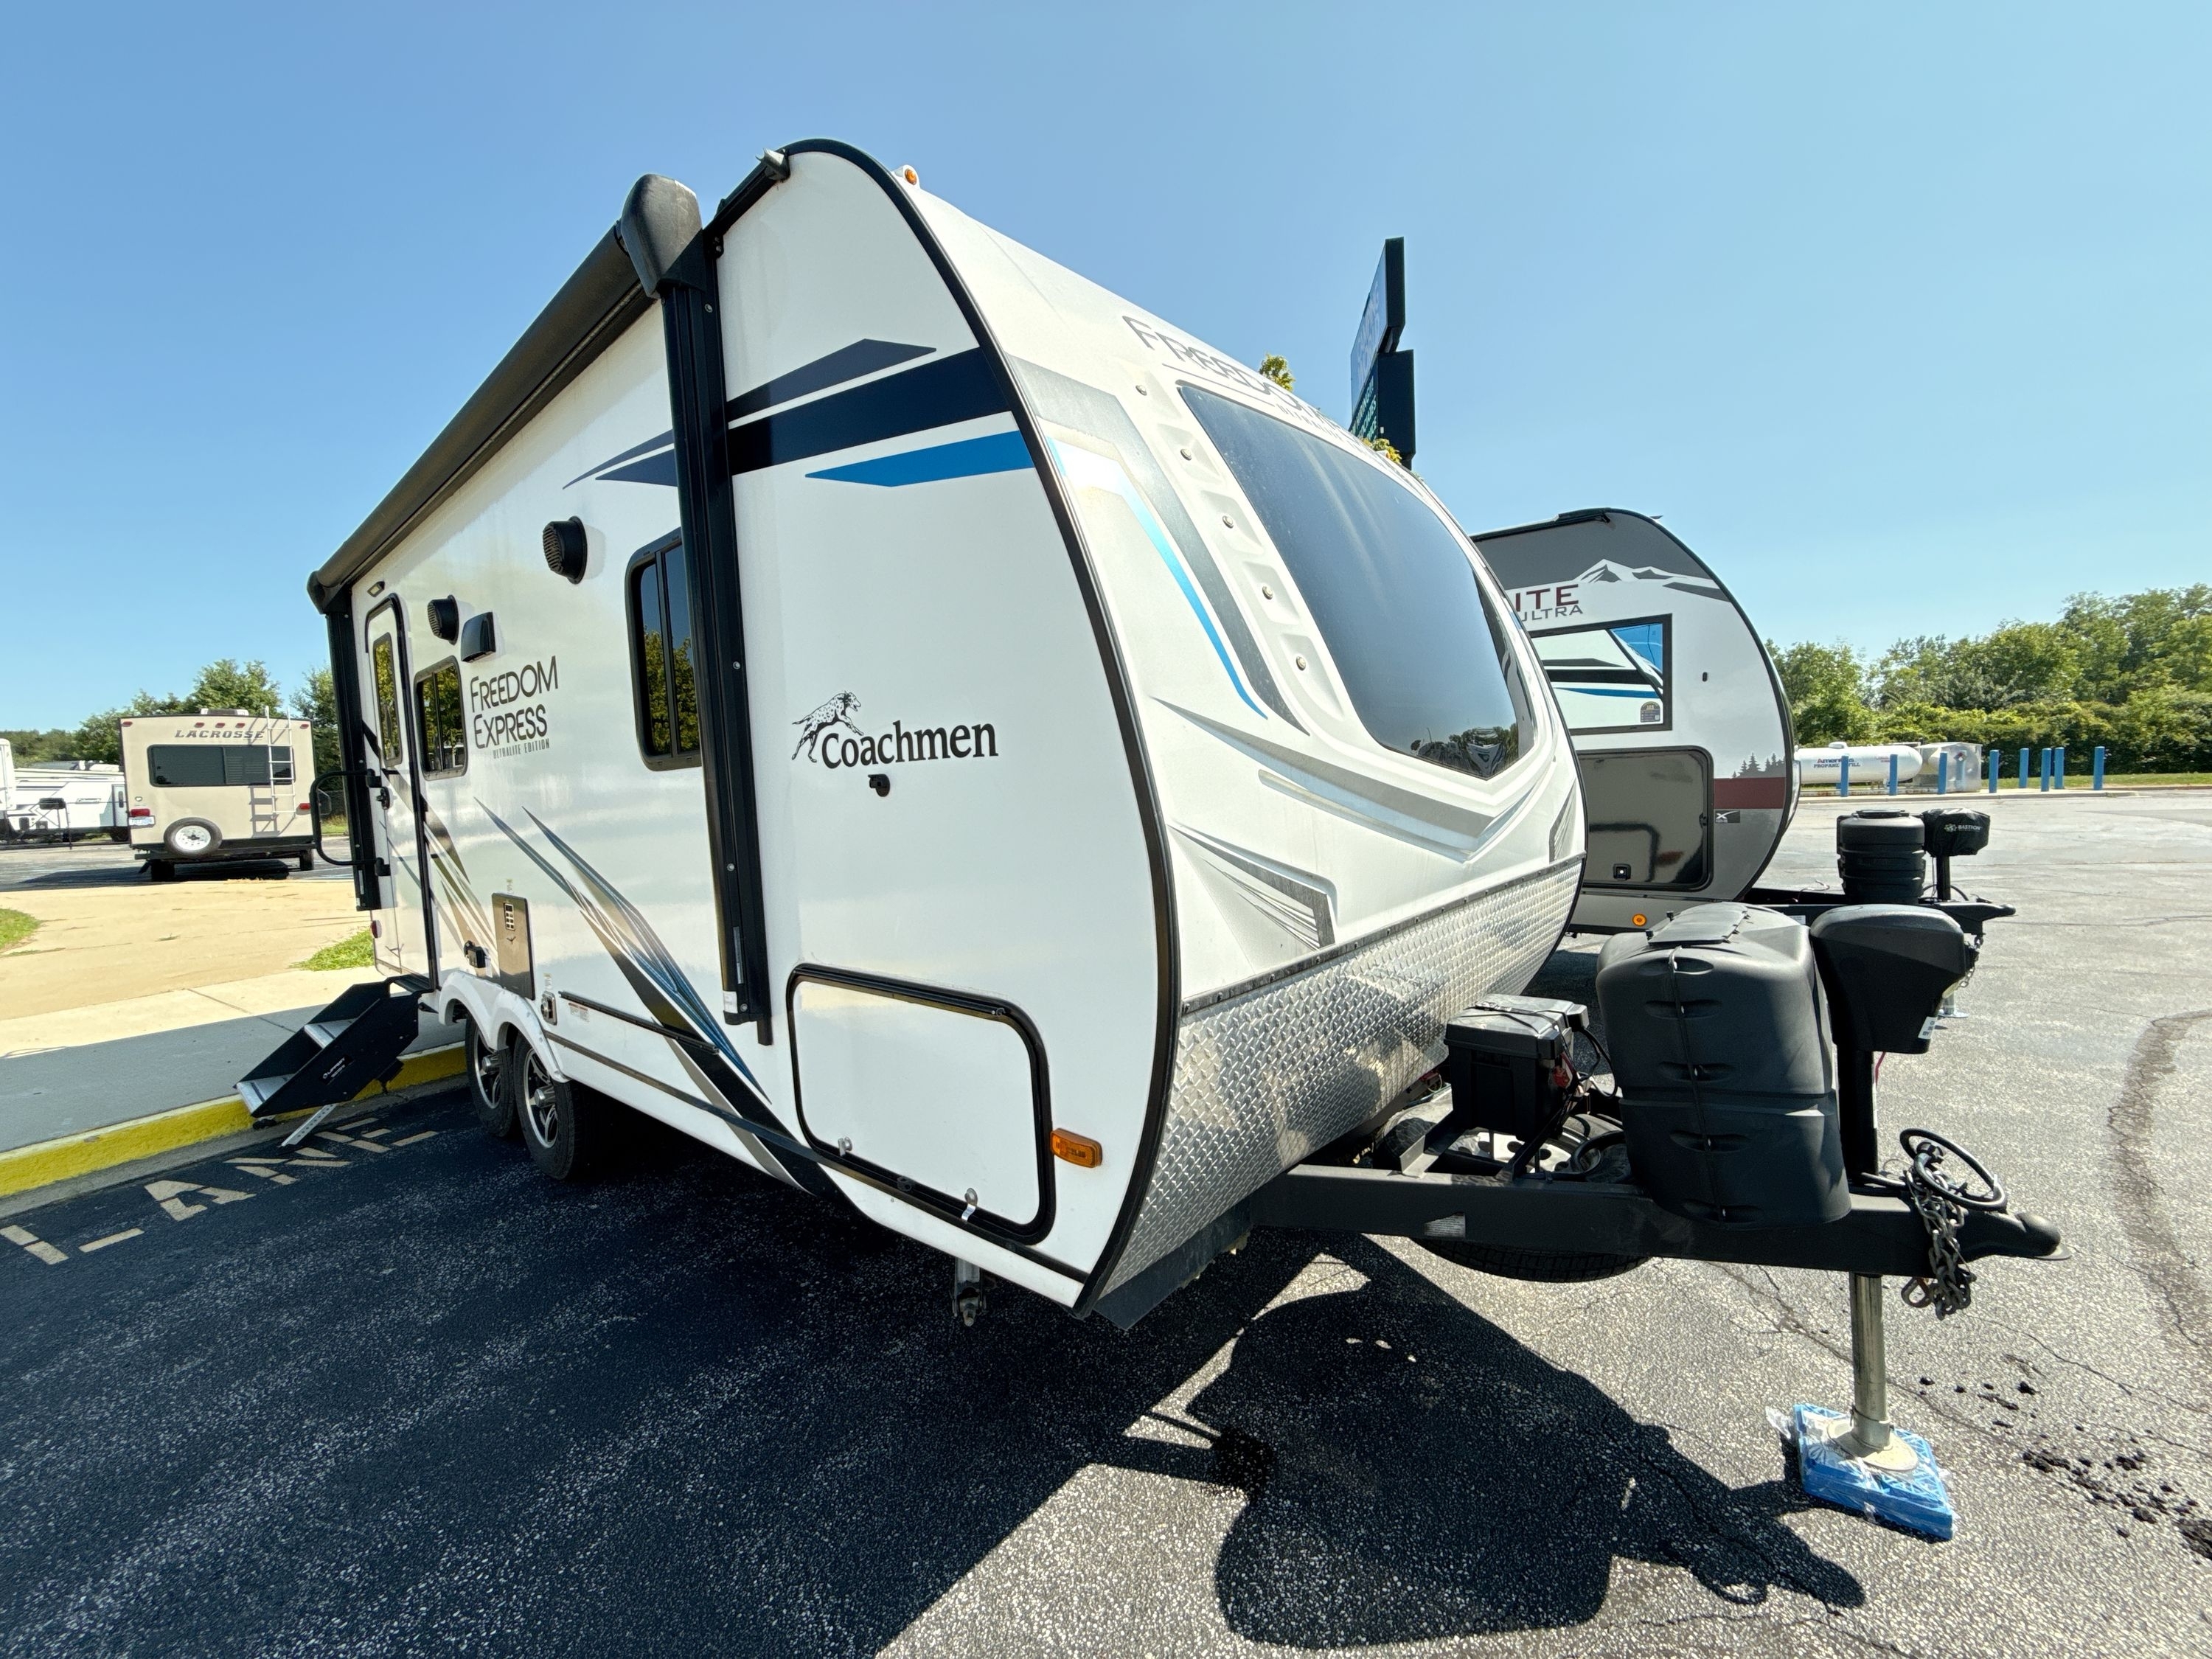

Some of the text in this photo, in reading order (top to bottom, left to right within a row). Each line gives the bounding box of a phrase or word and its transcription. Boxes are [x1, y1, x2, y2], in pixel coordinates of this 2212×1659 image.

[1515, 584, 1579, 612] ITE
[470, 655, 558, 712] FREEDOM
[175, 730, 265, 738] LACROSSE
[473, 703, 547, 749] EXPRESS
[821, 720, 998, 768] Coachmen
[493, 738, 549, 759] ULTRALITE EDITION
